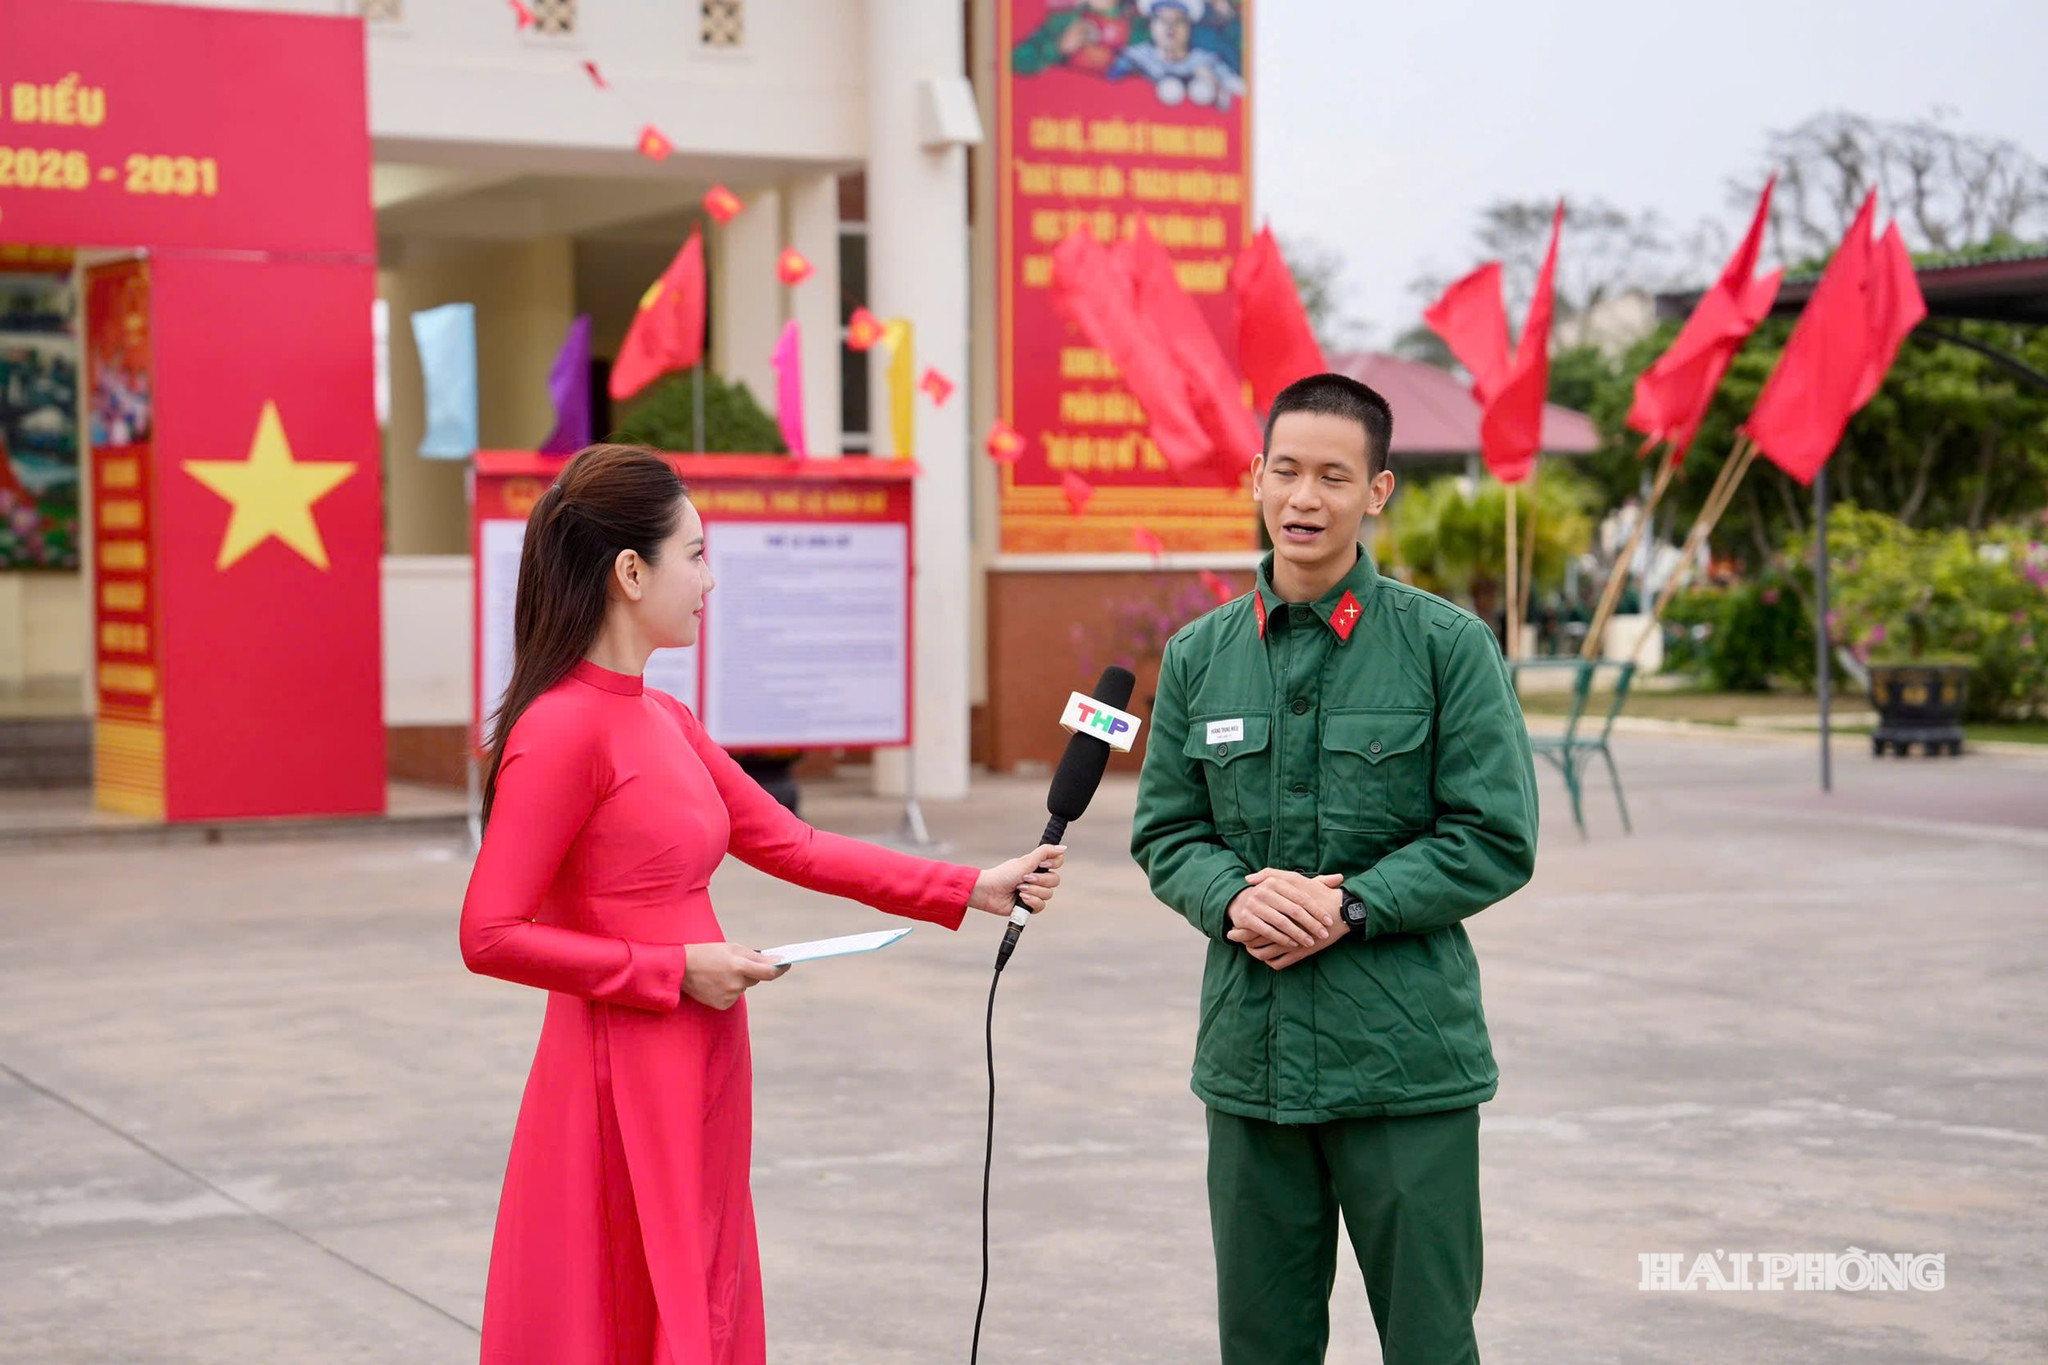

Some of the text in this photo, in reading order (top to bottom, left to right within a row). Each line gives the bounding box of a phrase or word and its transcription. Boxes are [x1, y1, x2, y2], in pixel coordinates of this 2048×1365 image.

[0, 145, 90, 190] 2026
[125, 153, 218, 196] 2031
[1077, 702, 1129, 735] THP
